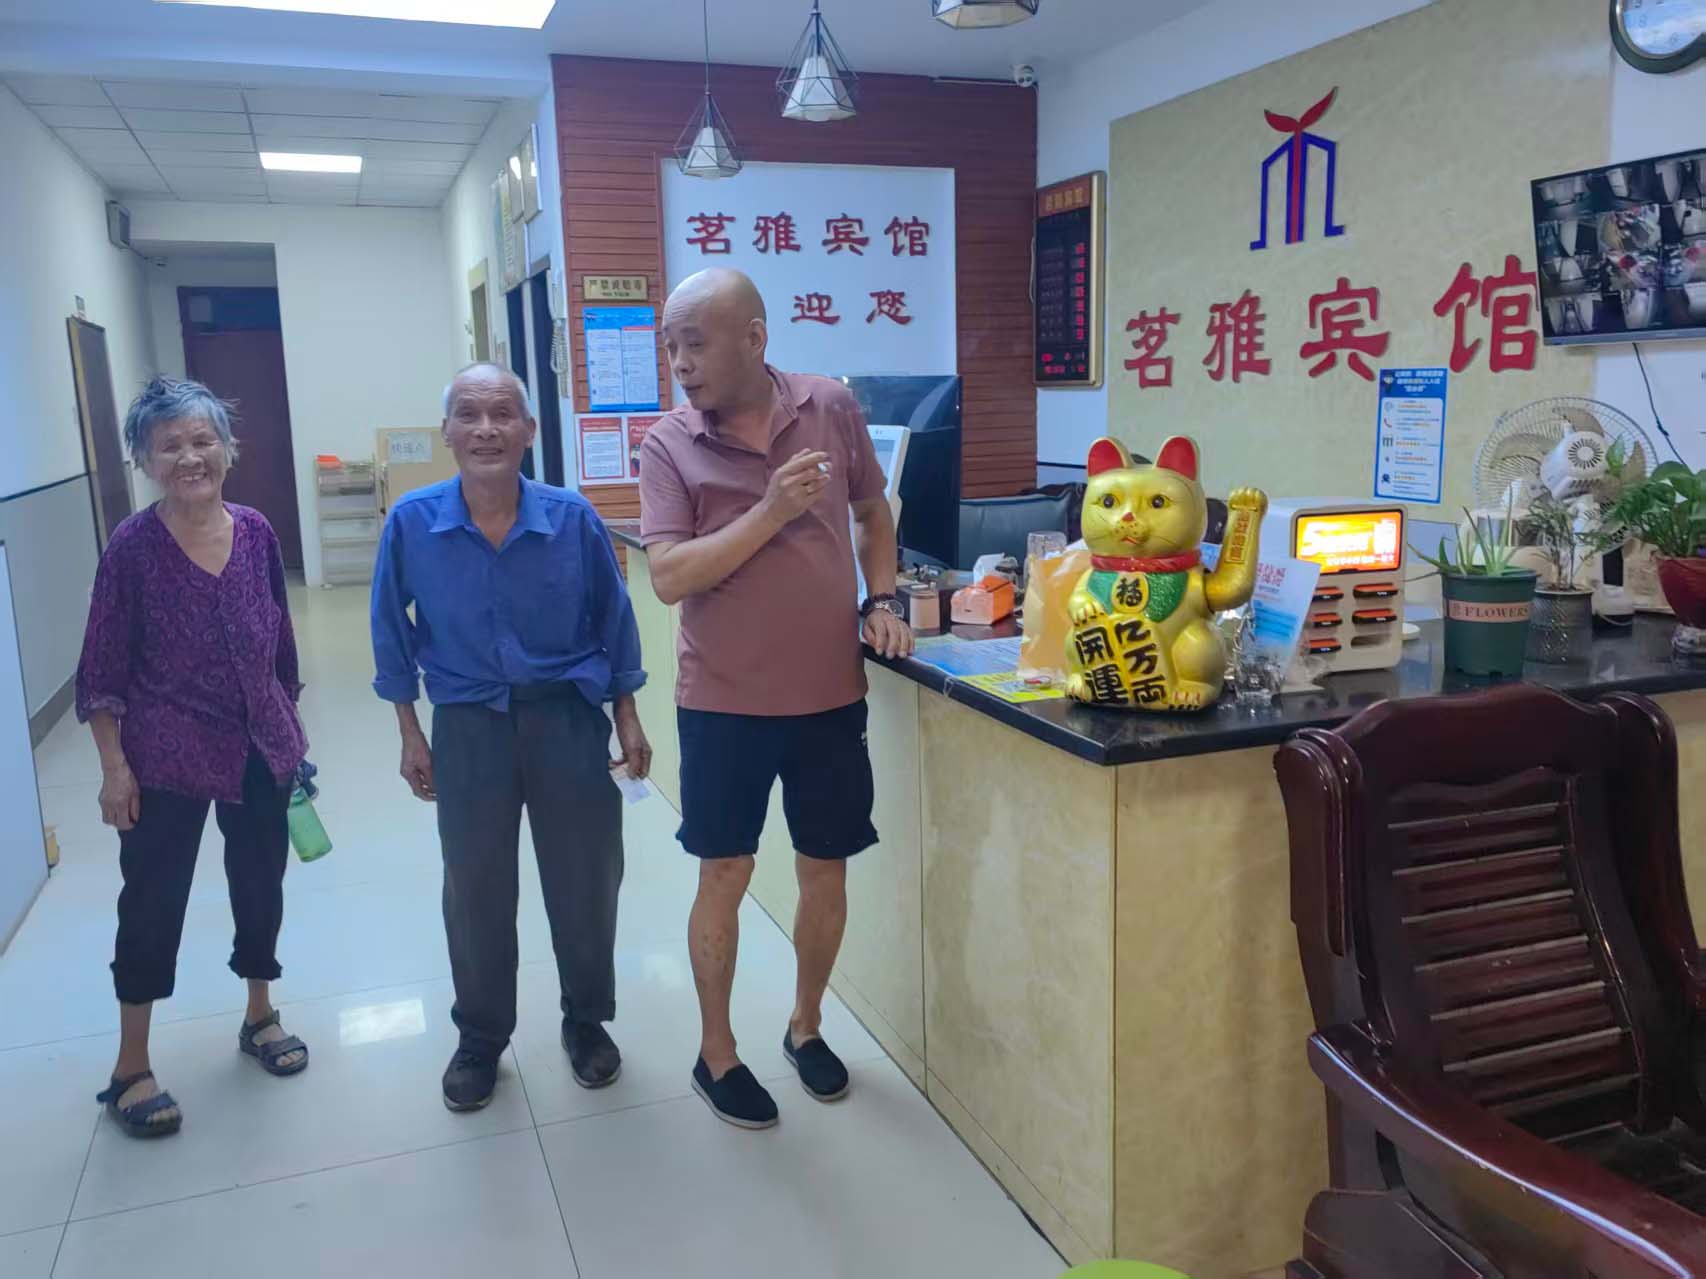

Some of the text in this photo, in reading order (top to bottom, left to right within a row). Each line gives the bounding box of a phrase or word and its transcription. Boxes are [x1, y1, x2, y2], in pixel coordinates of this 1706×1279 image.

[686, 211, 930, 257] 茗雅宾馆
[790, 289, 914, 326] 迎您
[1124, 254, 1539, 389] 茗雅宾馆
[1115, 577, 1144, 607] 福
